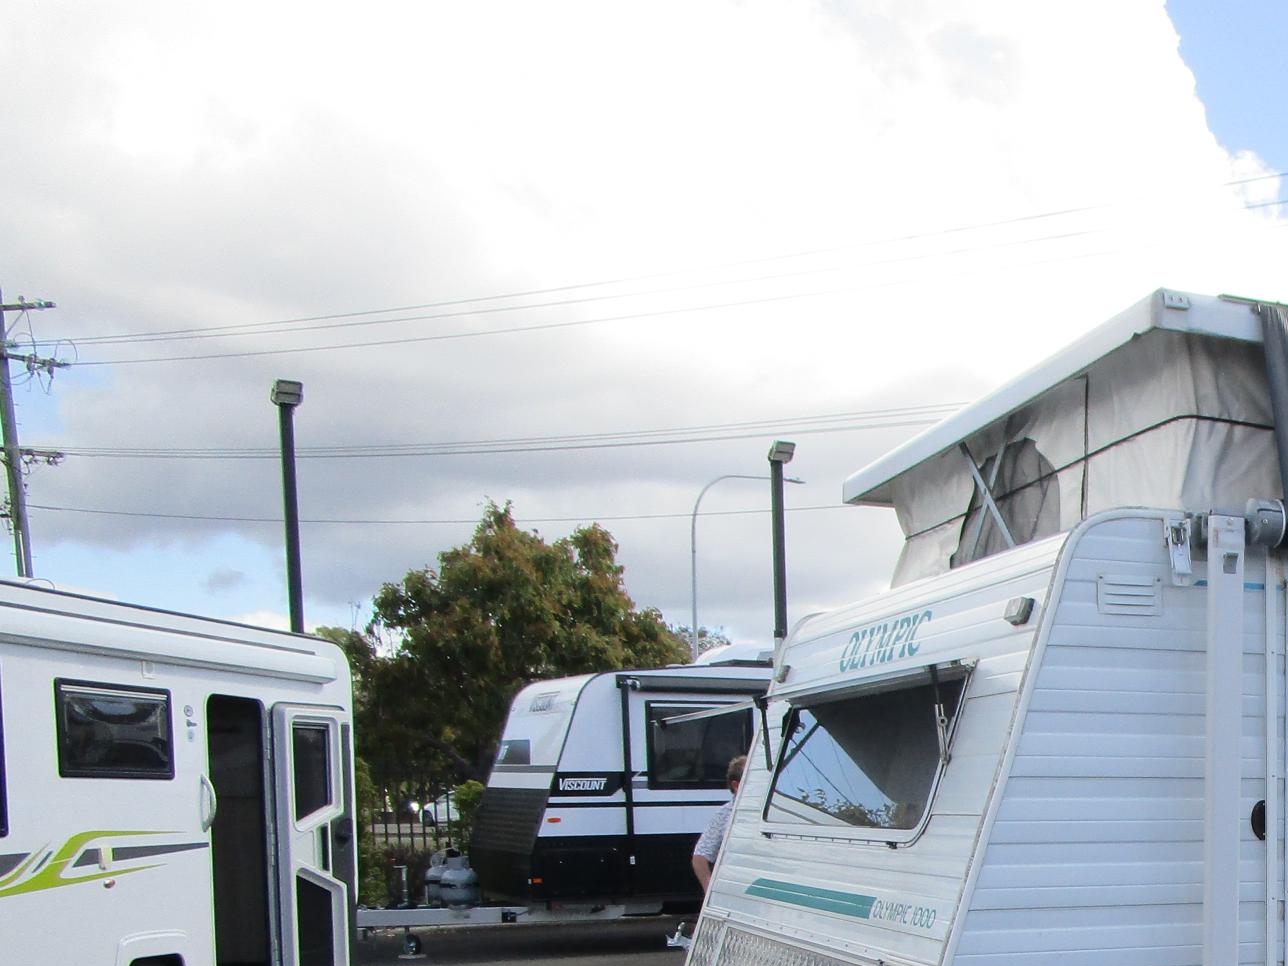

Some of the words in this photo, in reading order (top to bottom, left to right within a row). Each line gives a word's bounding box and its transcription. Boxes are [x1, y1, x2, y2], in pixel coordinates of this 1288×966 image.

[839, 610, 933, 673] OLYMPIC
[559, 778, 608, 791] VISCOUNT
[872, 899, 913, 924] OLYMPIC
[910, 906, 937, 929] 1000
